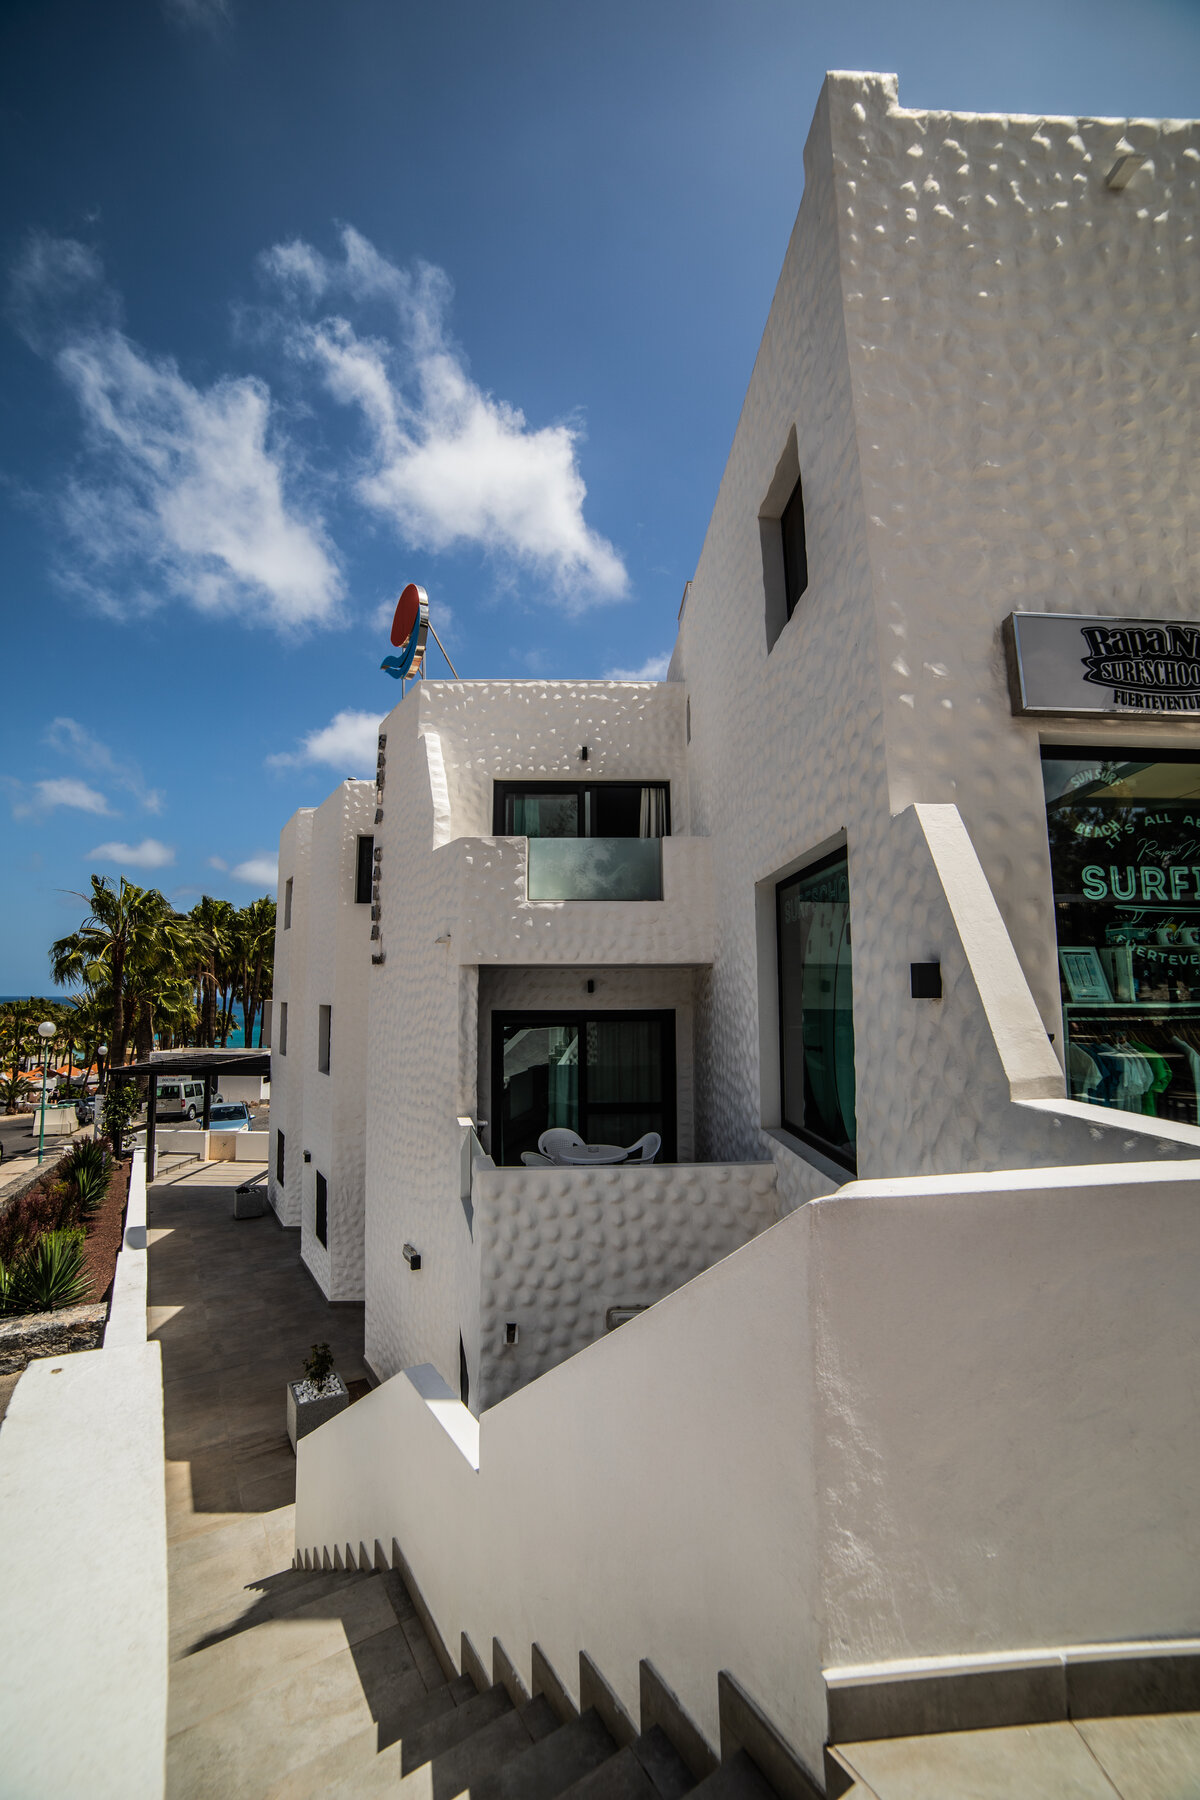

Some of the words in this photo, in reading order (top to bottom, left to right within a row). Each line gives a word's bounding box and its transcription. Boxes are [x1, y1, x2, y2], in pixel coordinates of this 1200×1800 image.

[1081, 626, 1167, 659] Rapa
[1070, 769, 1092, 788] SUN
[1074, 819, 1121, 838] BEACH
[1105, 823, 1135, 849] IT'S
[1144, 813, 1172, 827] ALL
[1116, 934, 1200, 966] FUERTEVE
